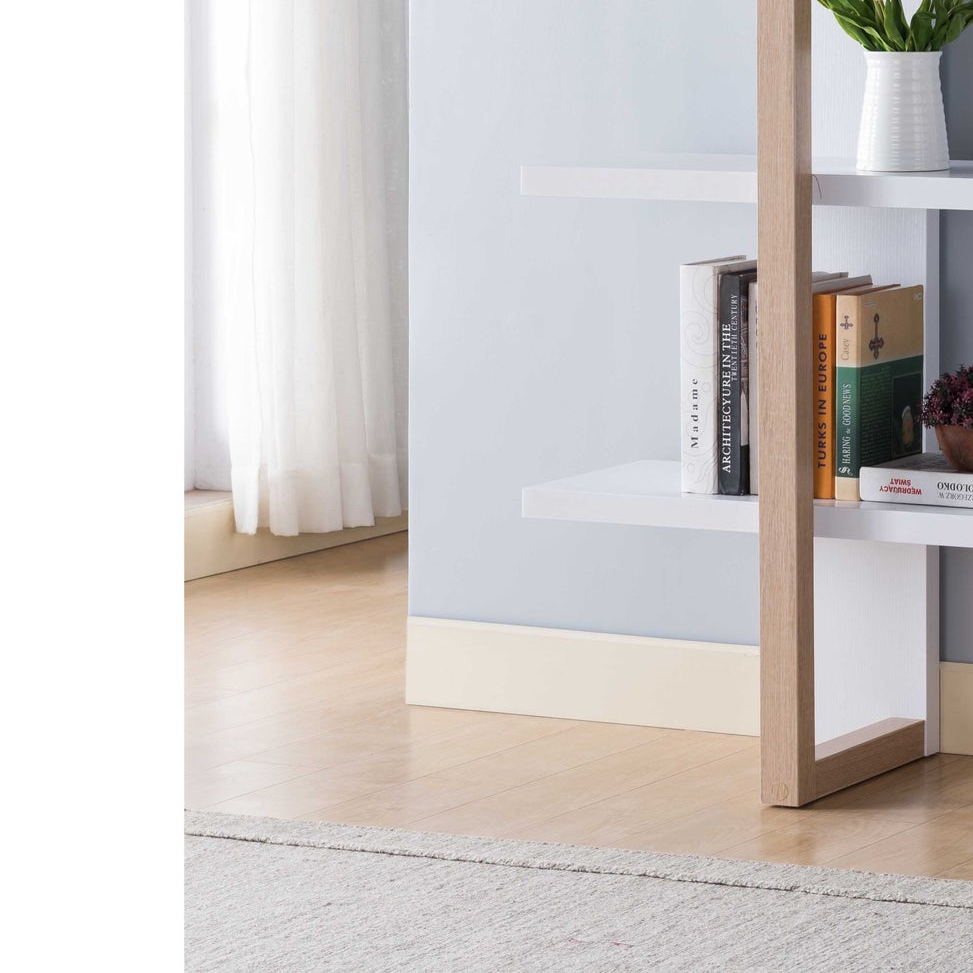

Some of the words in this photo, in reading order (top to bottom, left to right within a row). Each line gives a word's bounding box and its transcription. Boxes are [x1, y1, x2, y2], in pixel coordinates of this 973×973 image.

[722, 323, 731, 351] THE
[840, 338, 850, 361] Casey
[722, 354, 731, 368] IN
[818, 333, 827, 392] EUROPE
[842, 383, 851, 404] NEWS
[690, 379, 699, 449] Madame
[818, 399, 827, 415] IN
[842, 406, 851, 426] GOOD
[722, 371, 731, 473] ARCHITECYURE
[817, 422, 827, 469] TURKS
